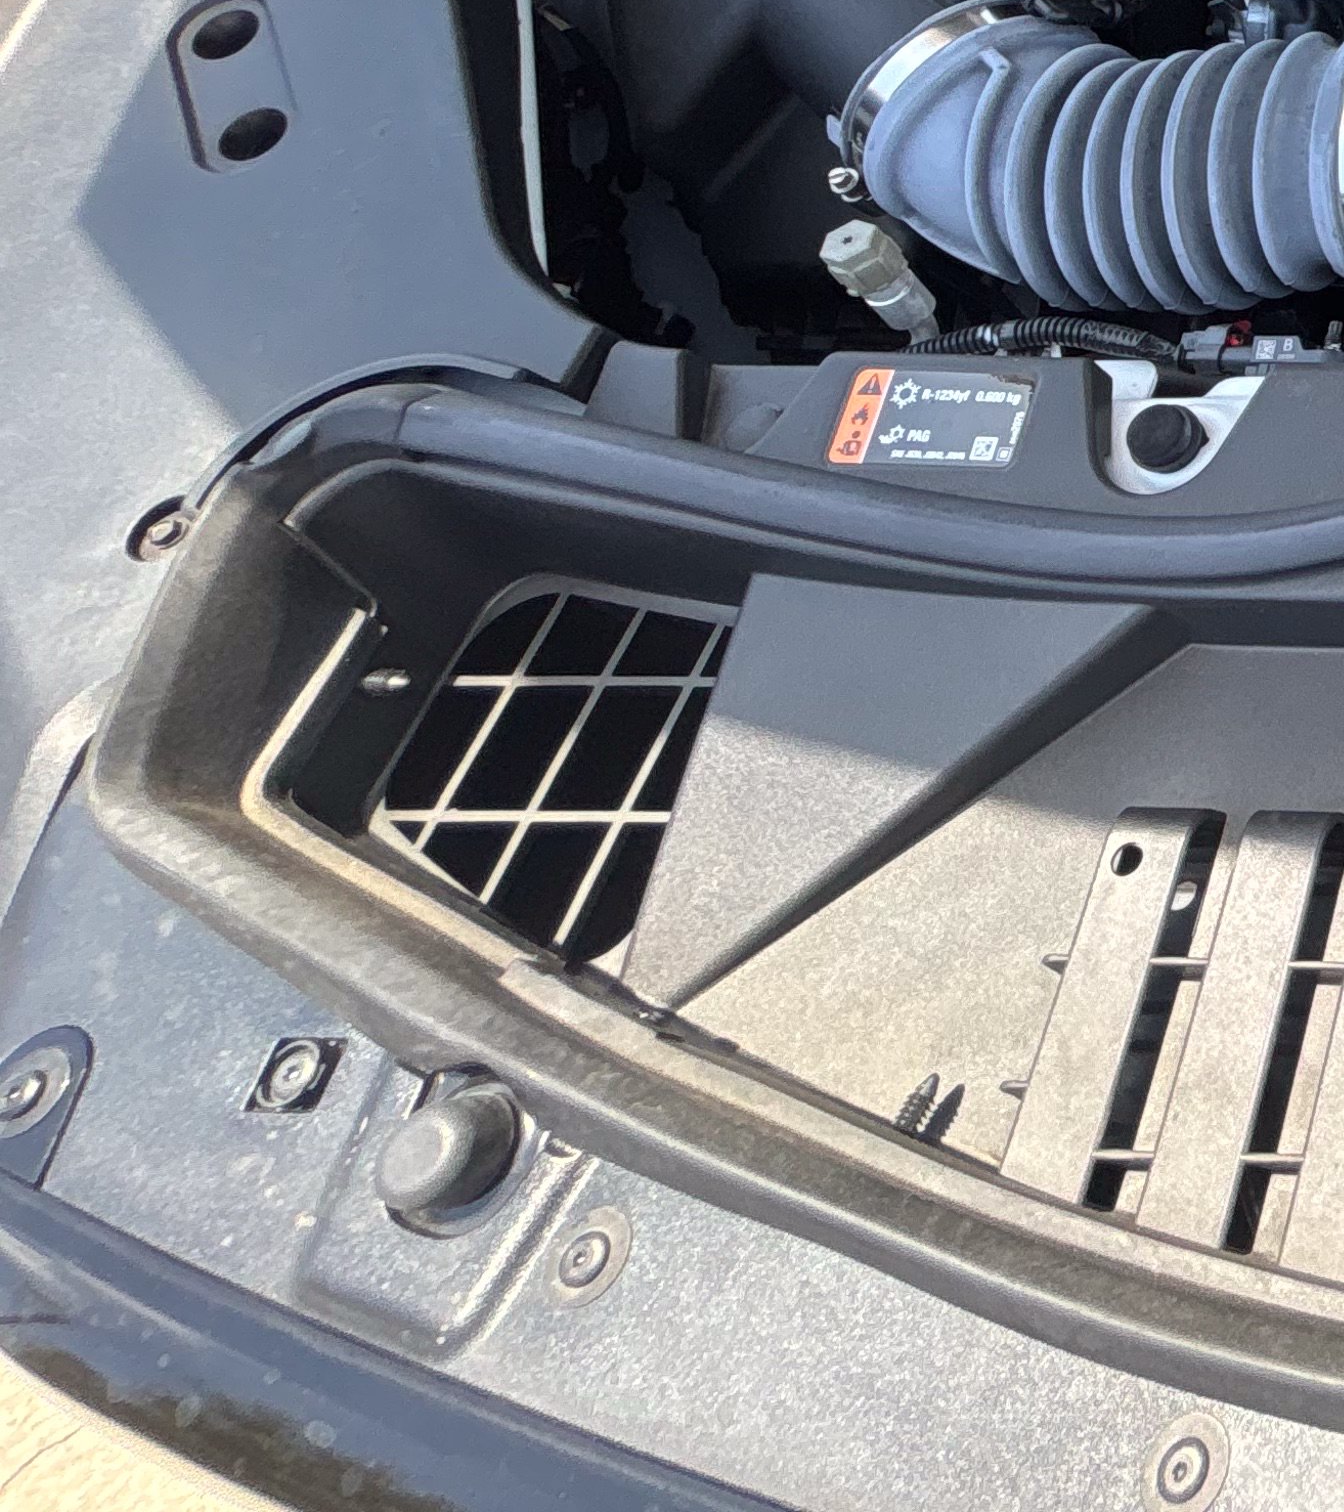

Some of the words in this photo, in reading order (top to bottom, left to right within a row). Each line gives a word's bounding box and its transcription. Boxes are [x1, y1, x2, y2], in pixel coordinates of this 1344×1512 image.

[1283, 337, 1294, 352] B
[922, 388, 971, 404] R-1234yf
[1006, 391, 1022, 405] kg
[906, 429, 932, 442] PAG
